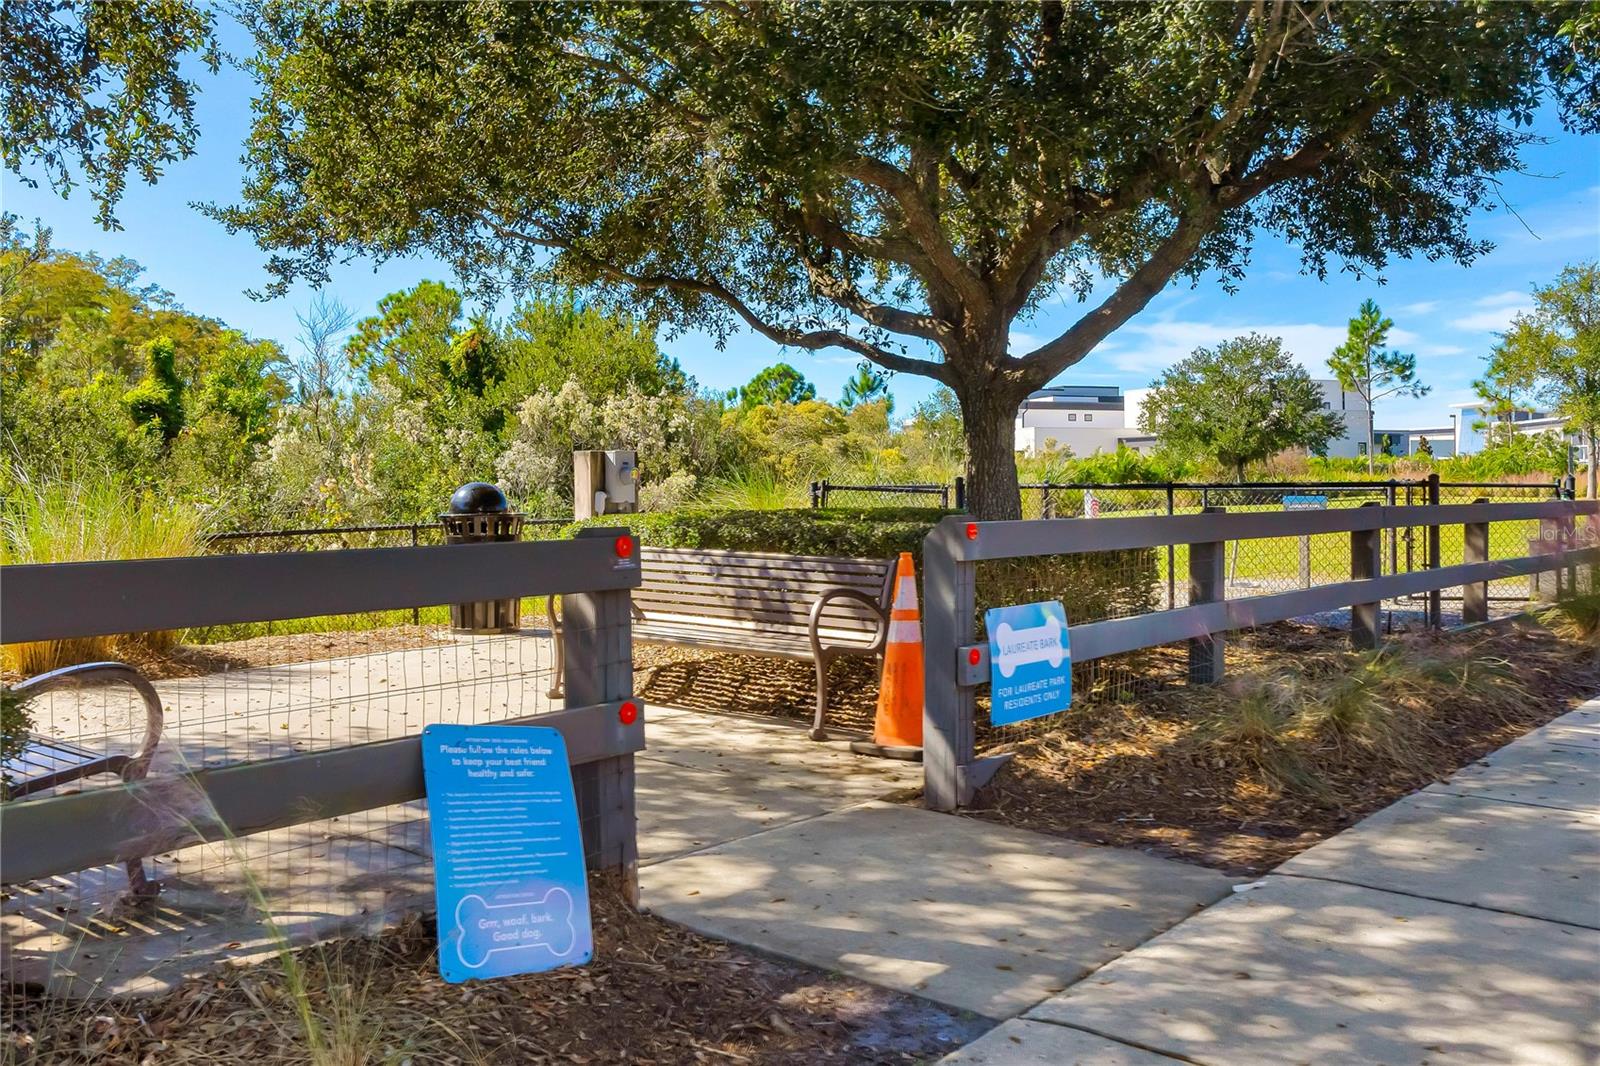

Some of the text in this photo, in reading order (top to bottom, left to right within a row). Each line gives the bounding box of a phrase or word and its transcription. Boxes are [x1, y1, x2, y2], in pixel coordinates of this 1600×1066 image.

[1002, 638, 1058, 656] LAUREATE BARK
[998, 675, 1066, 697] FOR LAUREATE PARK
[1003, 689, 1060, 711] RESIDENTS ONLY
[440, 744, 553, 755] Please follow the rules below
[451, 757, 461, 766] to
[462, 757, 483, 768] keep
[485, 758, 503, 768] your
[504, 757, 522, 766] best
[467, 768, 497, 779] healthy
[499, 768, 515, 778] and
[492, 927, 541, 942] Good dog.
